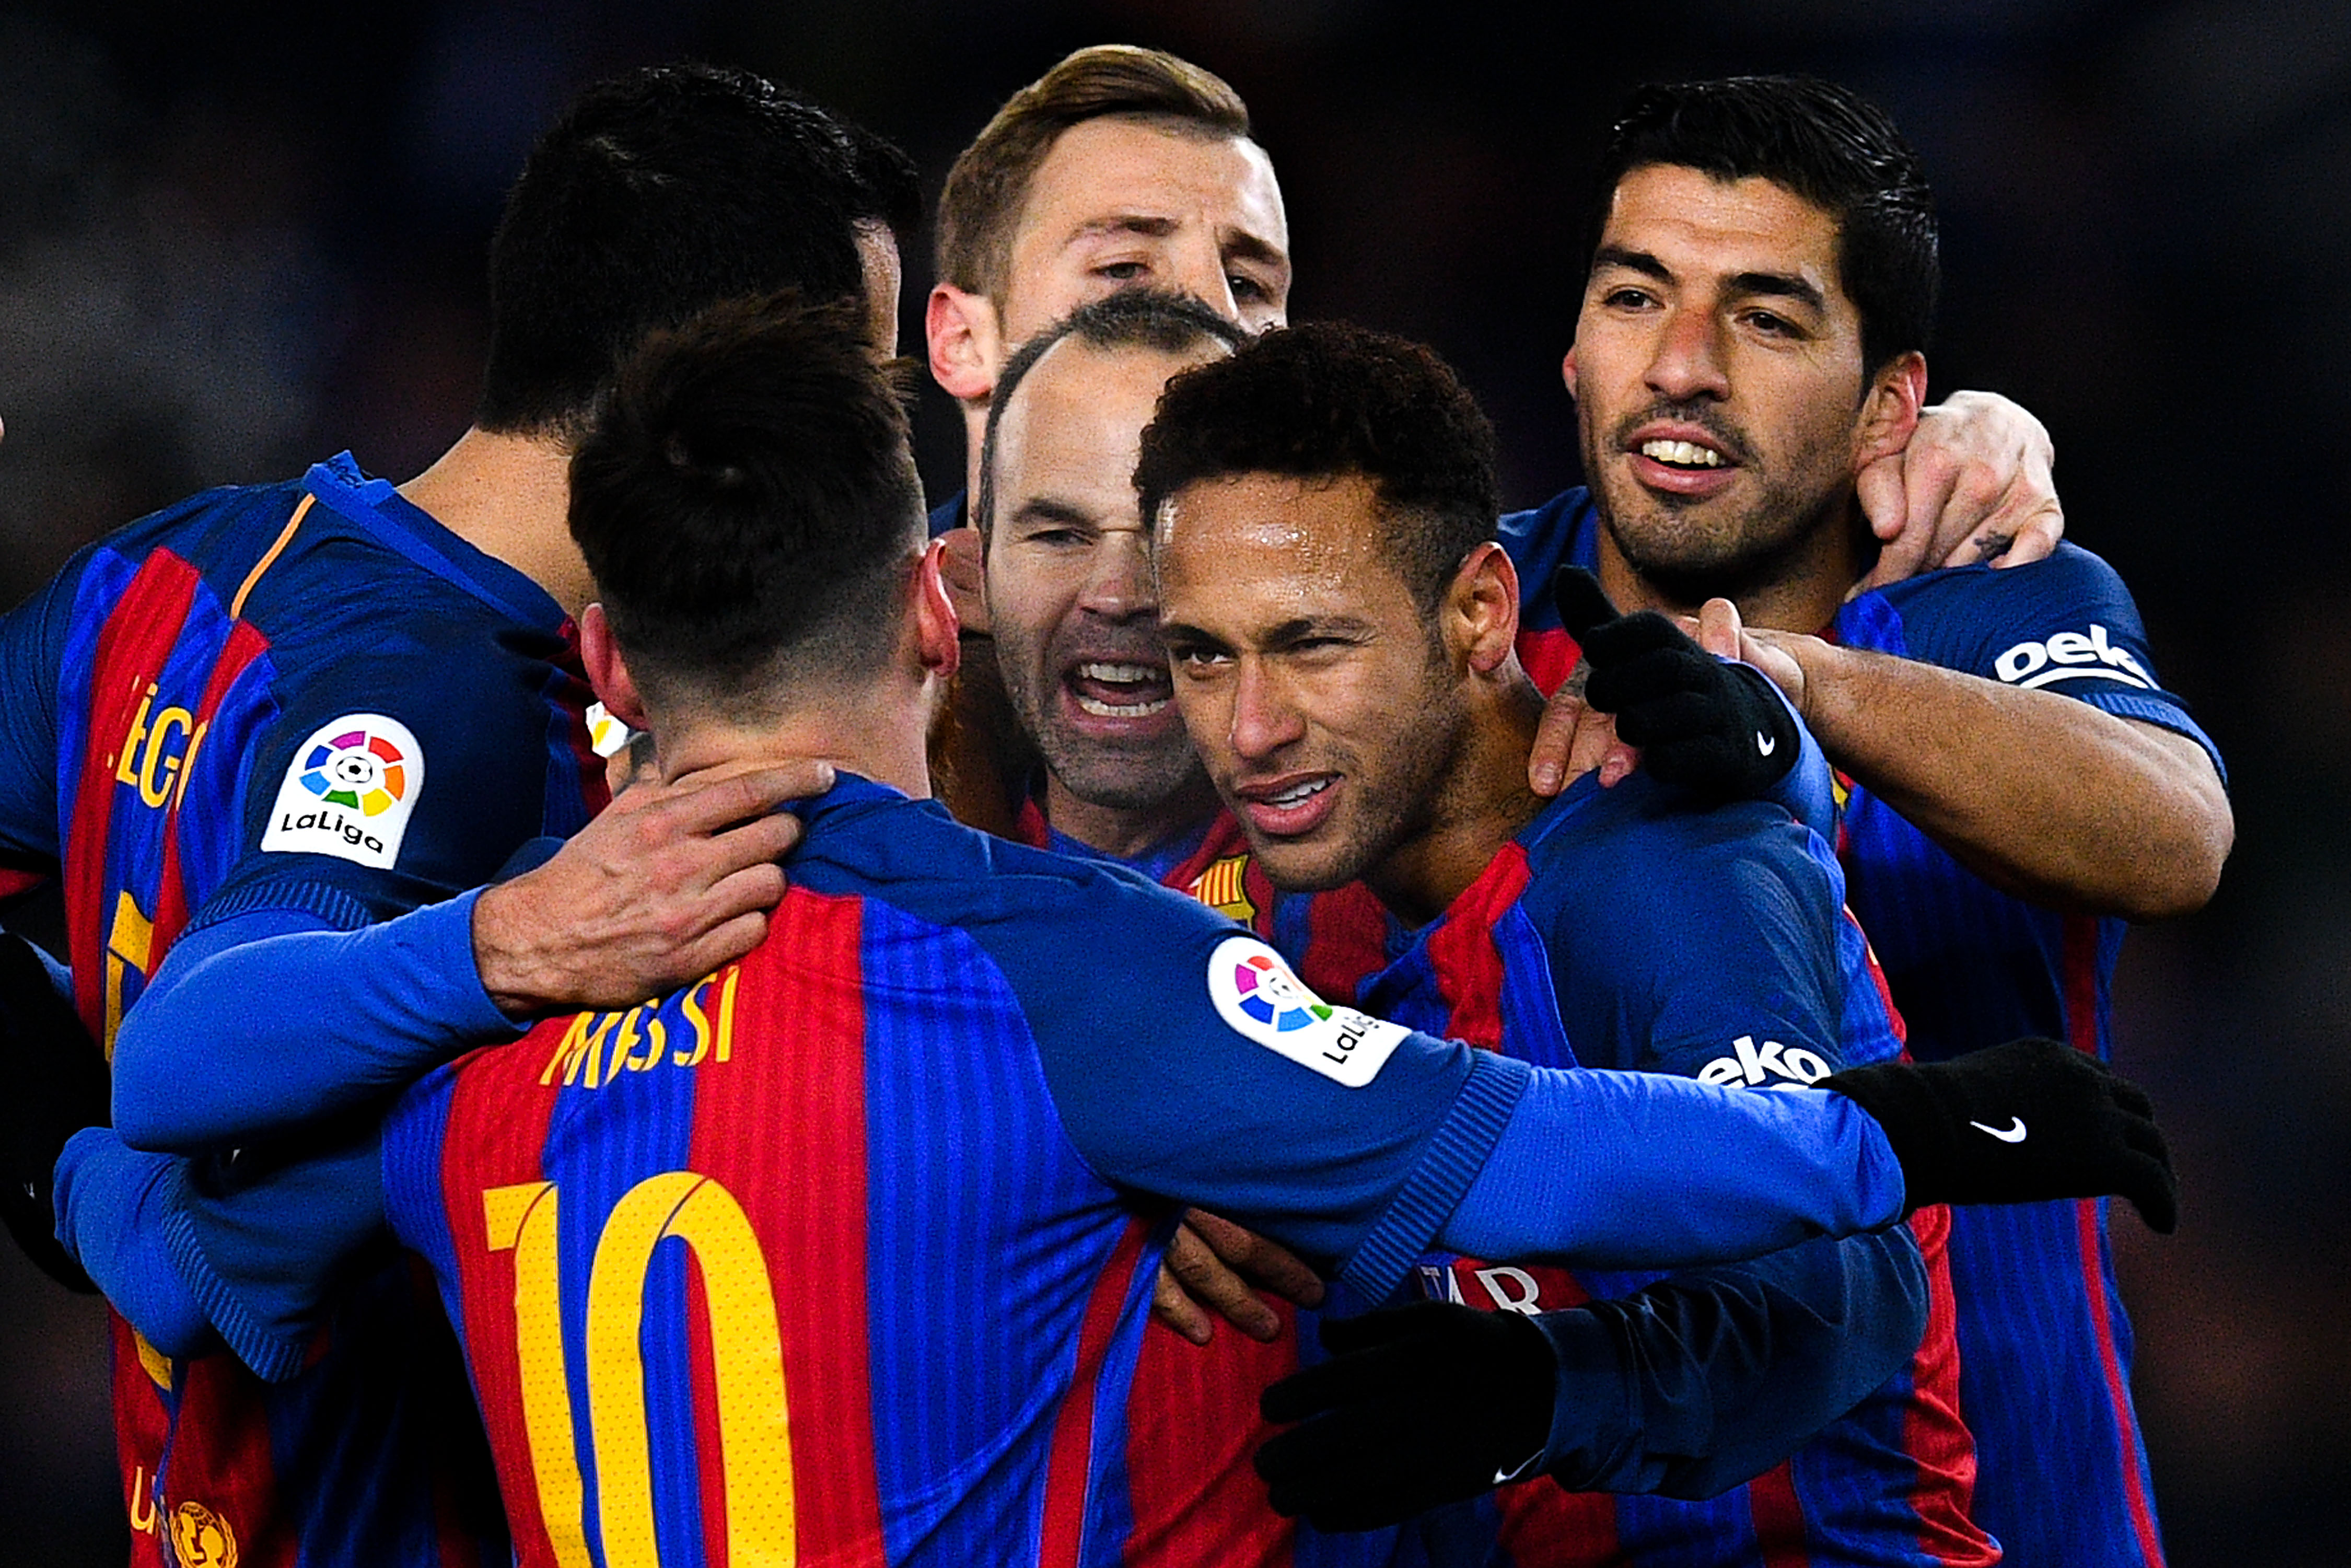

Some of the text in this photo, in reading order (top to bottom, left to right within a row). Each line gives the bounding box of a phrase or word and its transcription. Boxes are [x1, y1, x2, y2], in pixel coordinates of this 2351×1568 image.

[281, 810, 383, 854] LaLiga
[1697, 1035, 1832, 1089] eko
[482, 1171, 797, 1568] 10
